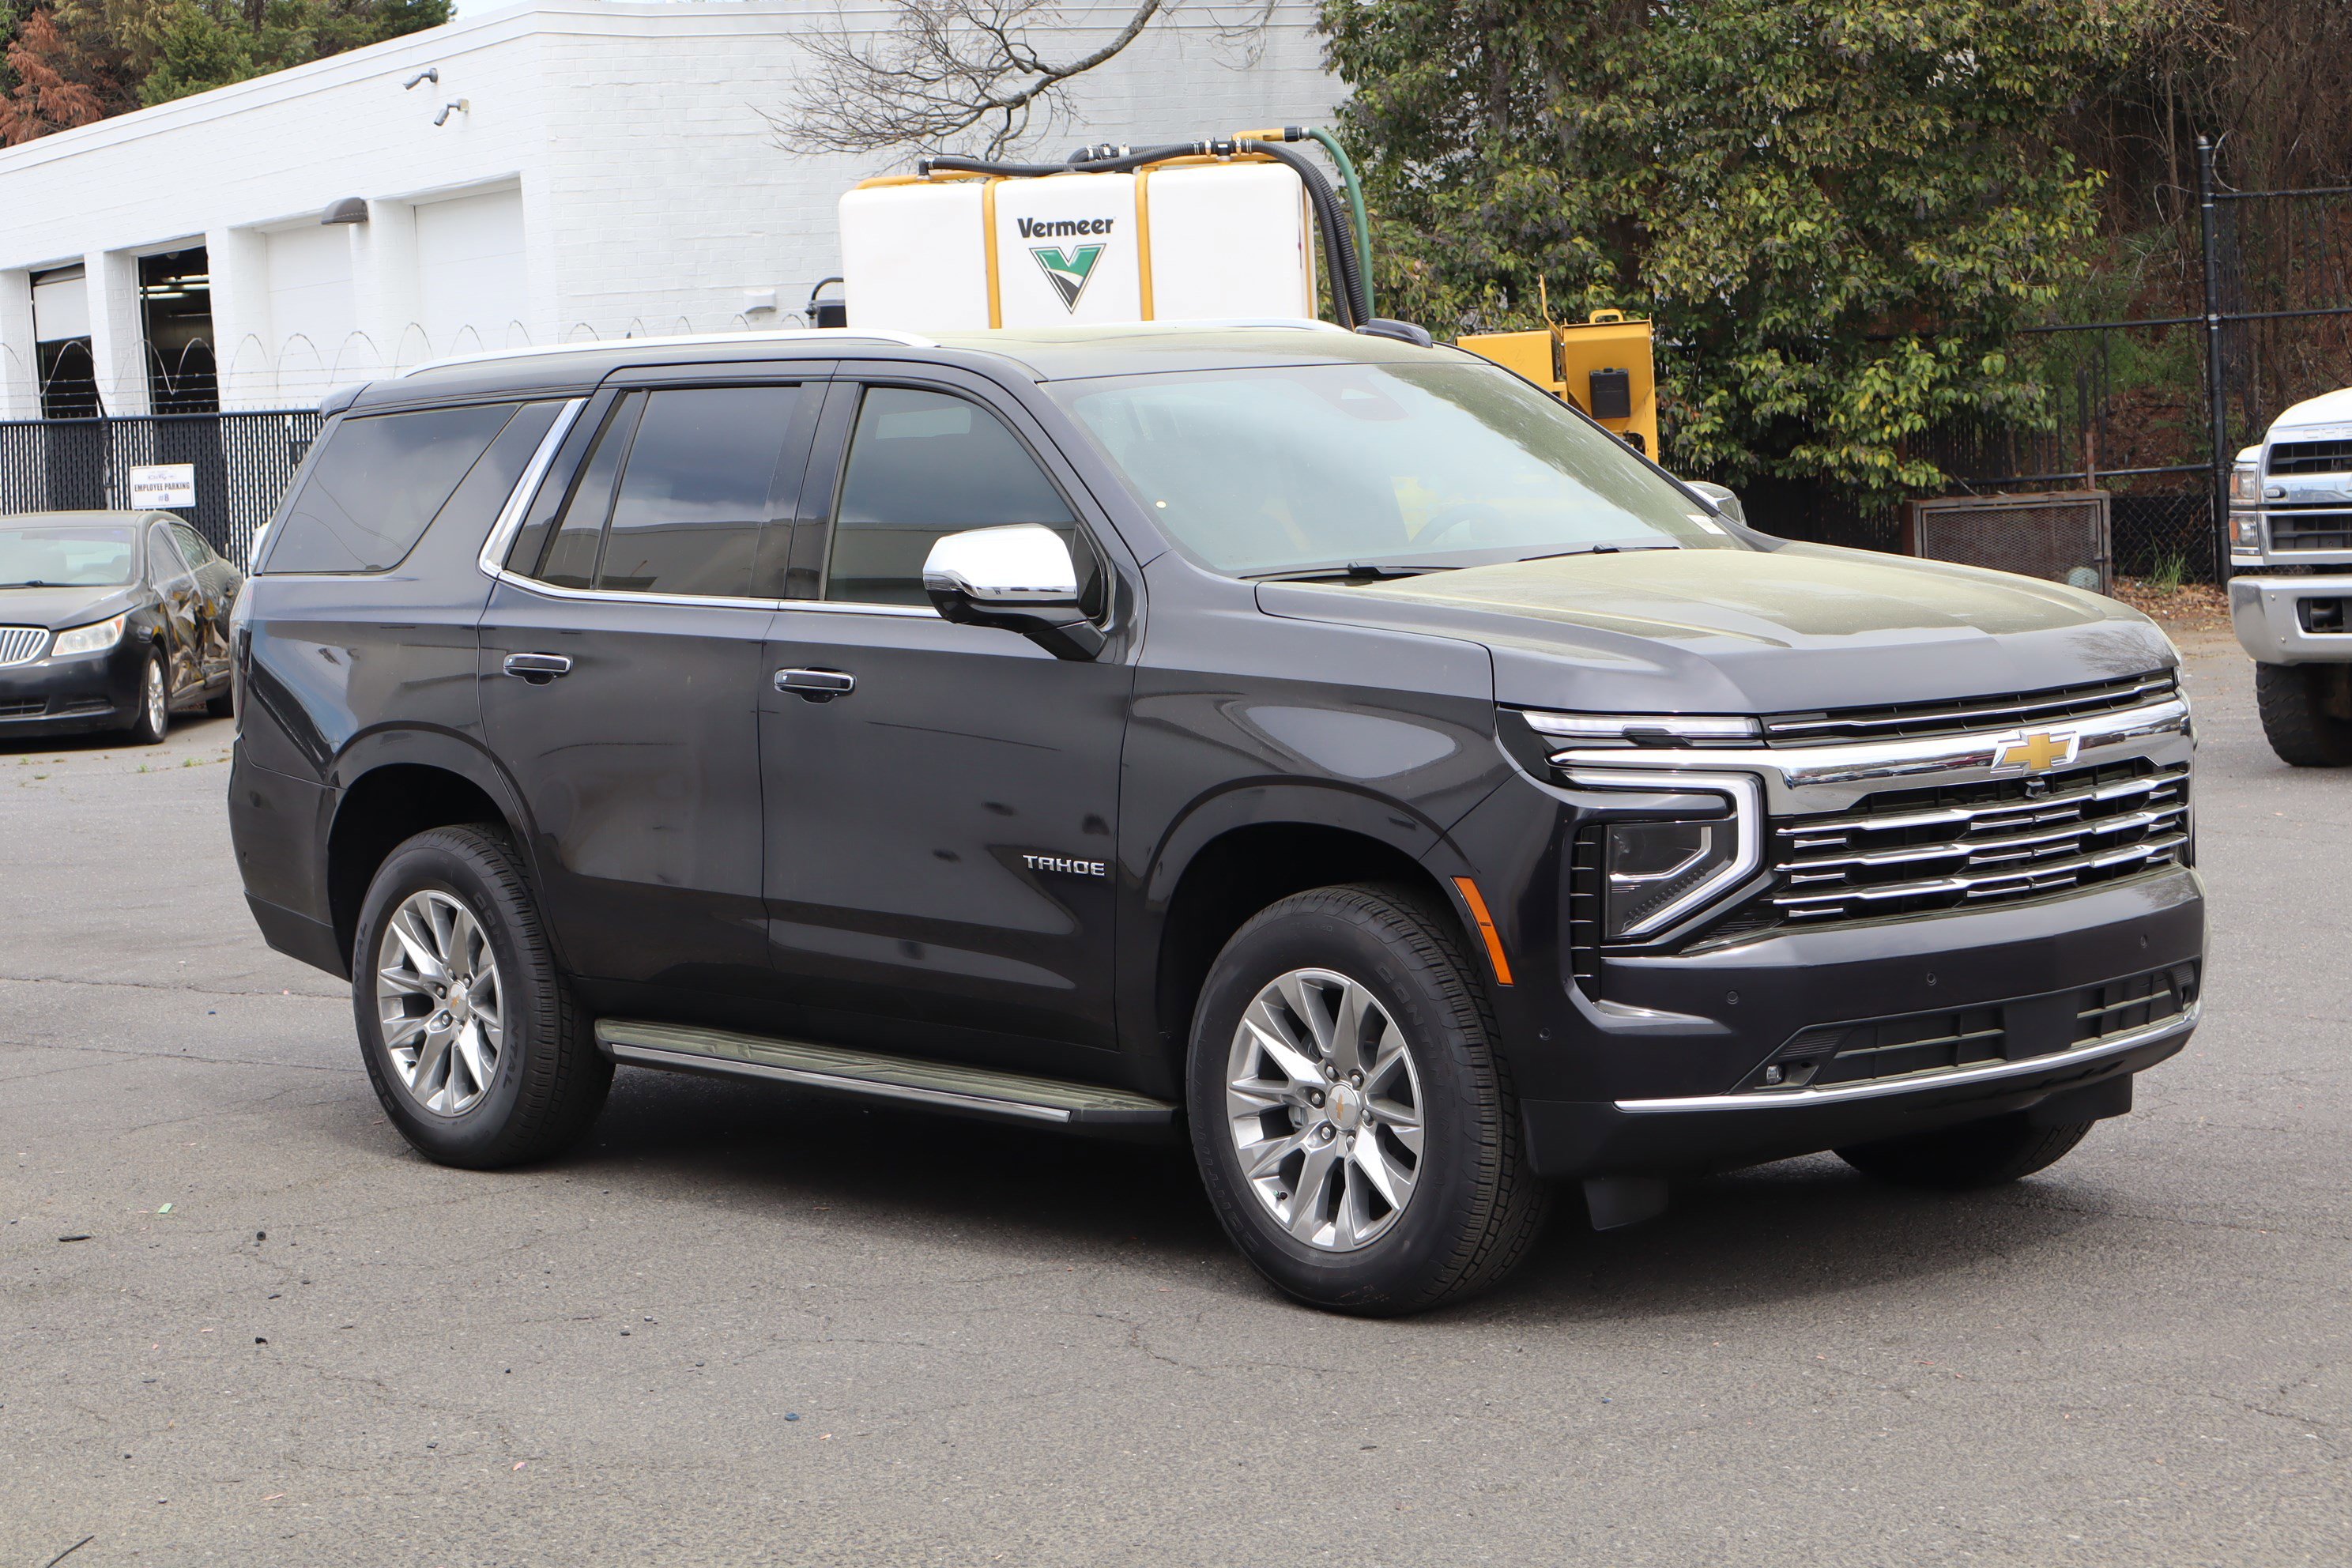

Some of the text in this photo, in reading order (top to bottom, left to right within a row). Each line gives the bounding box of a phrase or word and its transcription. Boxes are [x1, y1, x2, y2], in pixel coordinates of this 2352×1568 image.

[1017, 217, 1114, 238] Vermeer
[134, 481, 190, 492] EMPLOYEE PARKING
[1022, 854, 1106, 876] TAHOE
